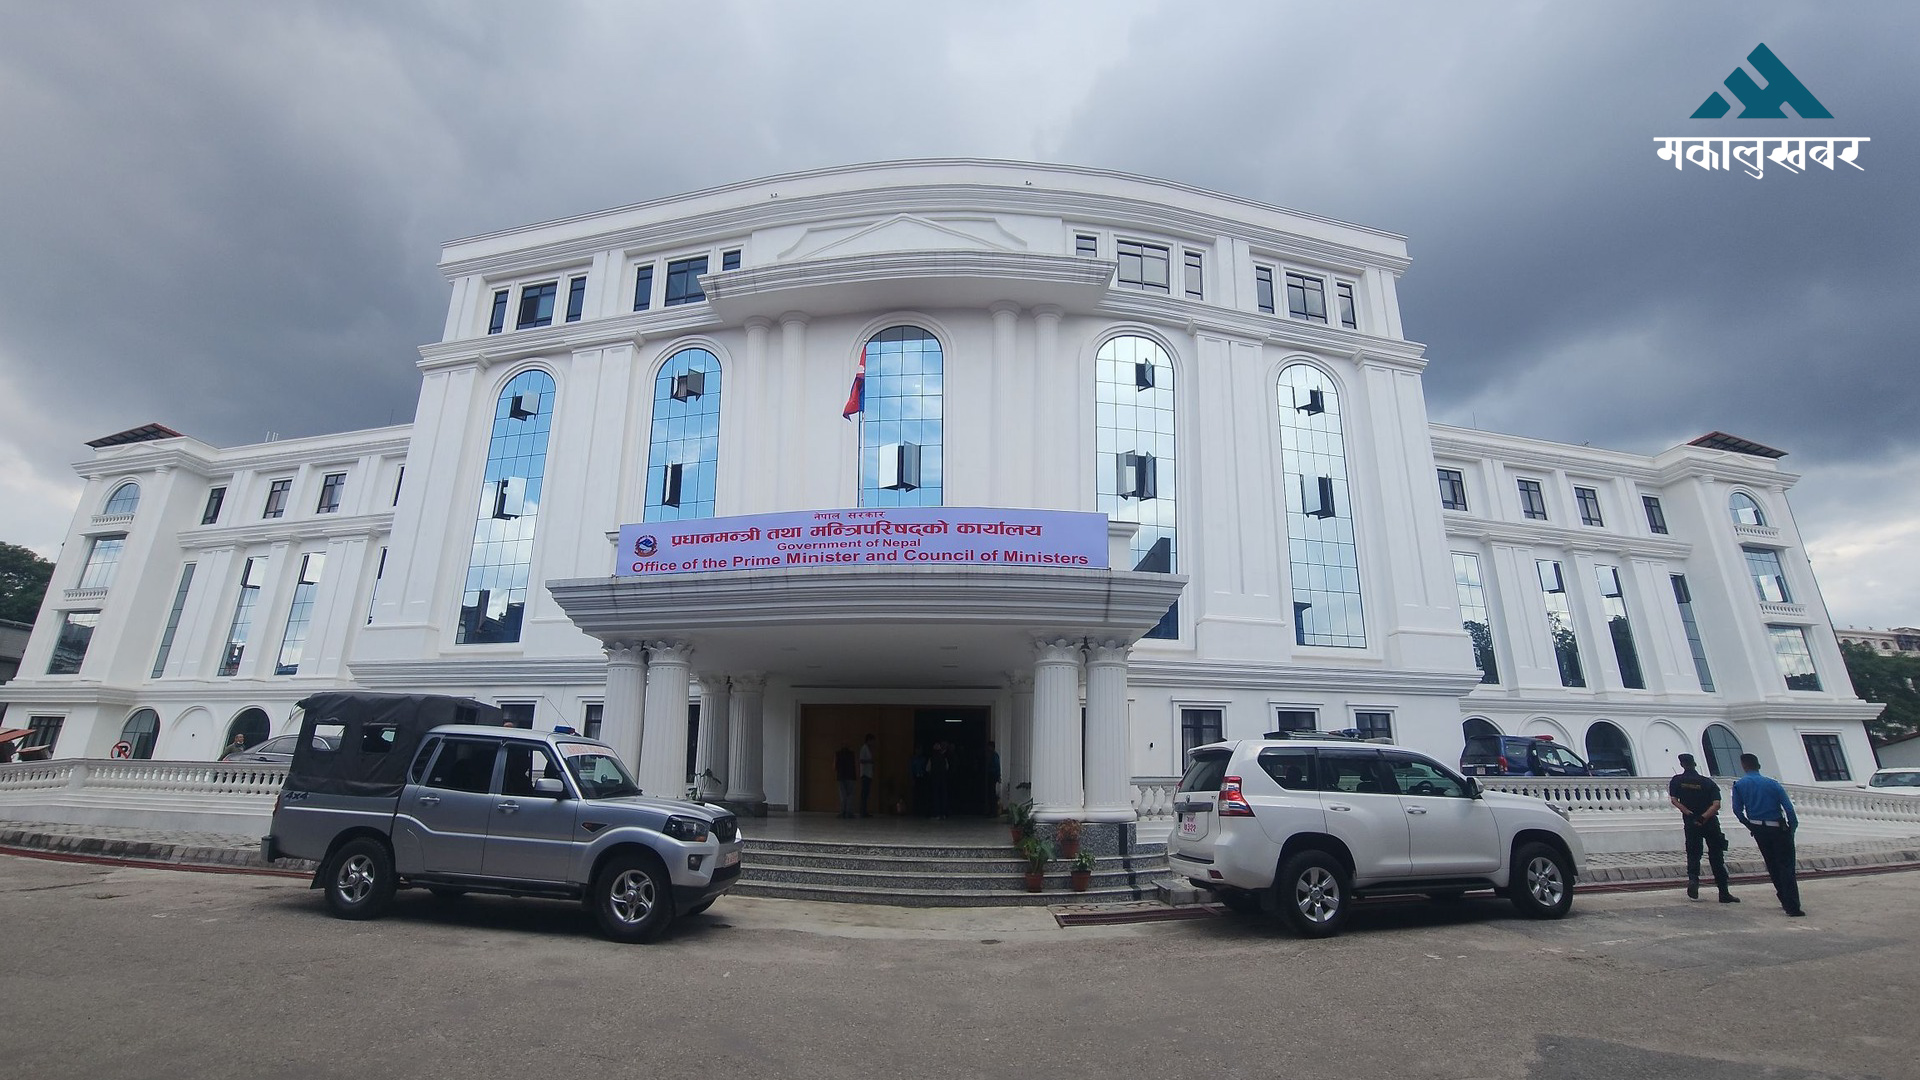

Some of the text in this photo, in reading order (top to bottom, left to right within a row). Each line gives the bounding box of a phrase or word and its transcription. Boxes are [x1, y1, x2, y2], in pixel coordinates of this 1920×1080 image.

[814, 510, 885, 520] नेपाल सरकार
[671, 527, 761, 547] प्रधानमन्त्री
[767, 527, 802, 540] तथा
[956, 521, 1043, 536] कार्यालय
[777, 538, 921, 550] Government of Nepal
[632, 549, 1089, 572] Office of the Prime Minister and Council of Ministers
